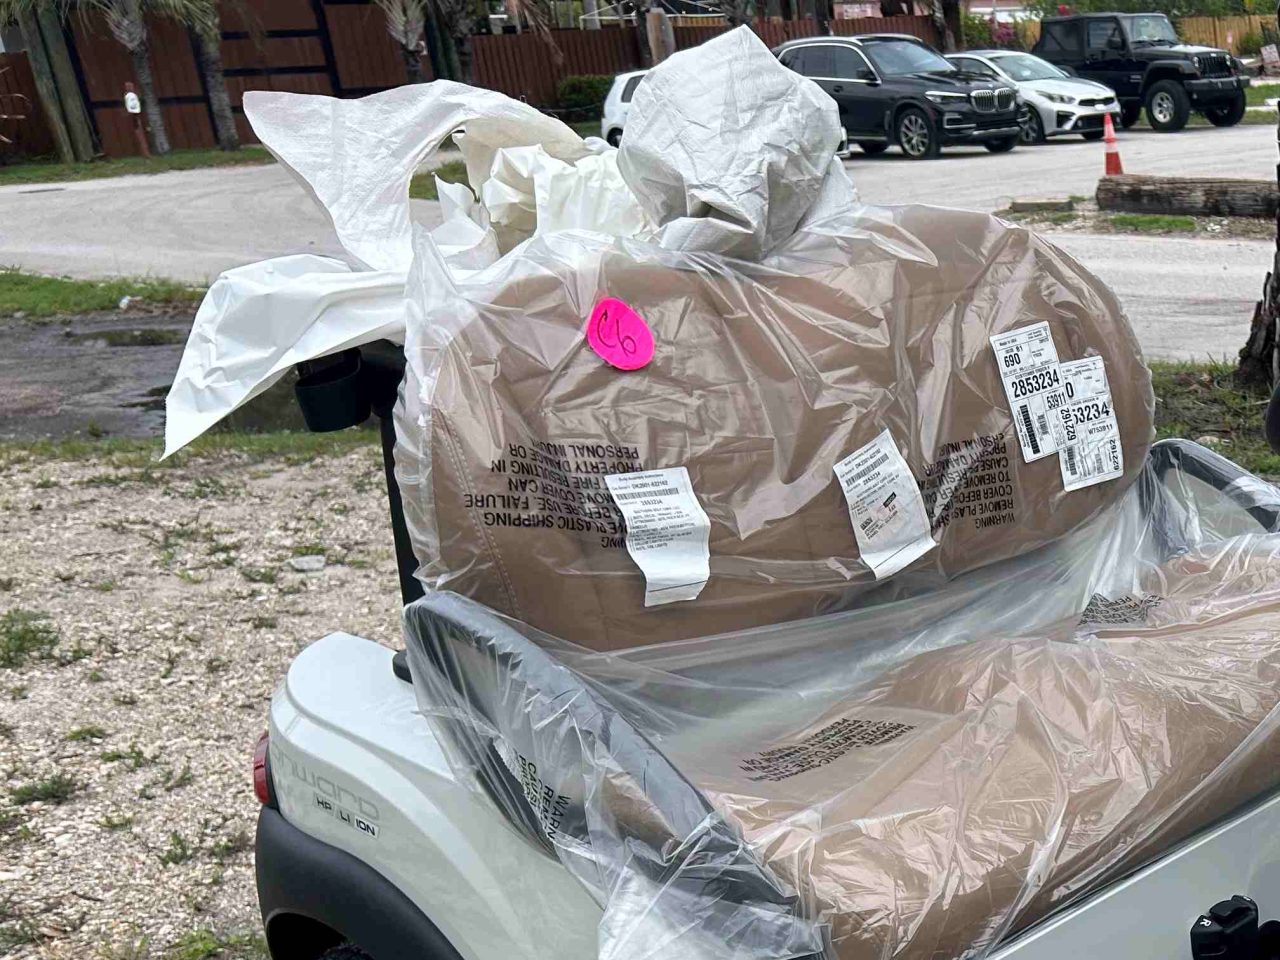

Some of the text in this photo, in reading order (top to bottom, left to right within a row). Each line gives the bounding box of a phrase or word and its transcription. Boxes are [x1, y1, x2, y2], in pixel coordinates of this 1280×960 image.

[1004, 353, 1021, 368] 690
[1012, 369, 1060, 398] 2853234
[1061, 407, 1077, 441] 622162
[509, 443, 527, 458] OR
[569, 445, 639, 459] PERSONAL
[1109, 439, 1120, 471] 622162
[491, 460, 506, 473] IN
[575, 461, 642, 474] PROPERTY
[981, 457, 1009, 472] CAUSE
[508, 478, 539, 493] CAN
[571, 477, 600, 490] FIRE
[964, 471, 1011, 489] TO REMOVE
[983, 484, 1013, 500] COVER
[464, 494, 529, 510] FAILURE
[980, 498, 1014, 513] REMOVE
[484, 512, 554, 528] SHIPPING
[557, 516, 606, 534] PLASTIC
[975, 513, 1016, 529] WARNING
[316, 797, 332, 810] HP
[355, 818, 376, 837] ION
[1200, 918, 1212, 927] R
